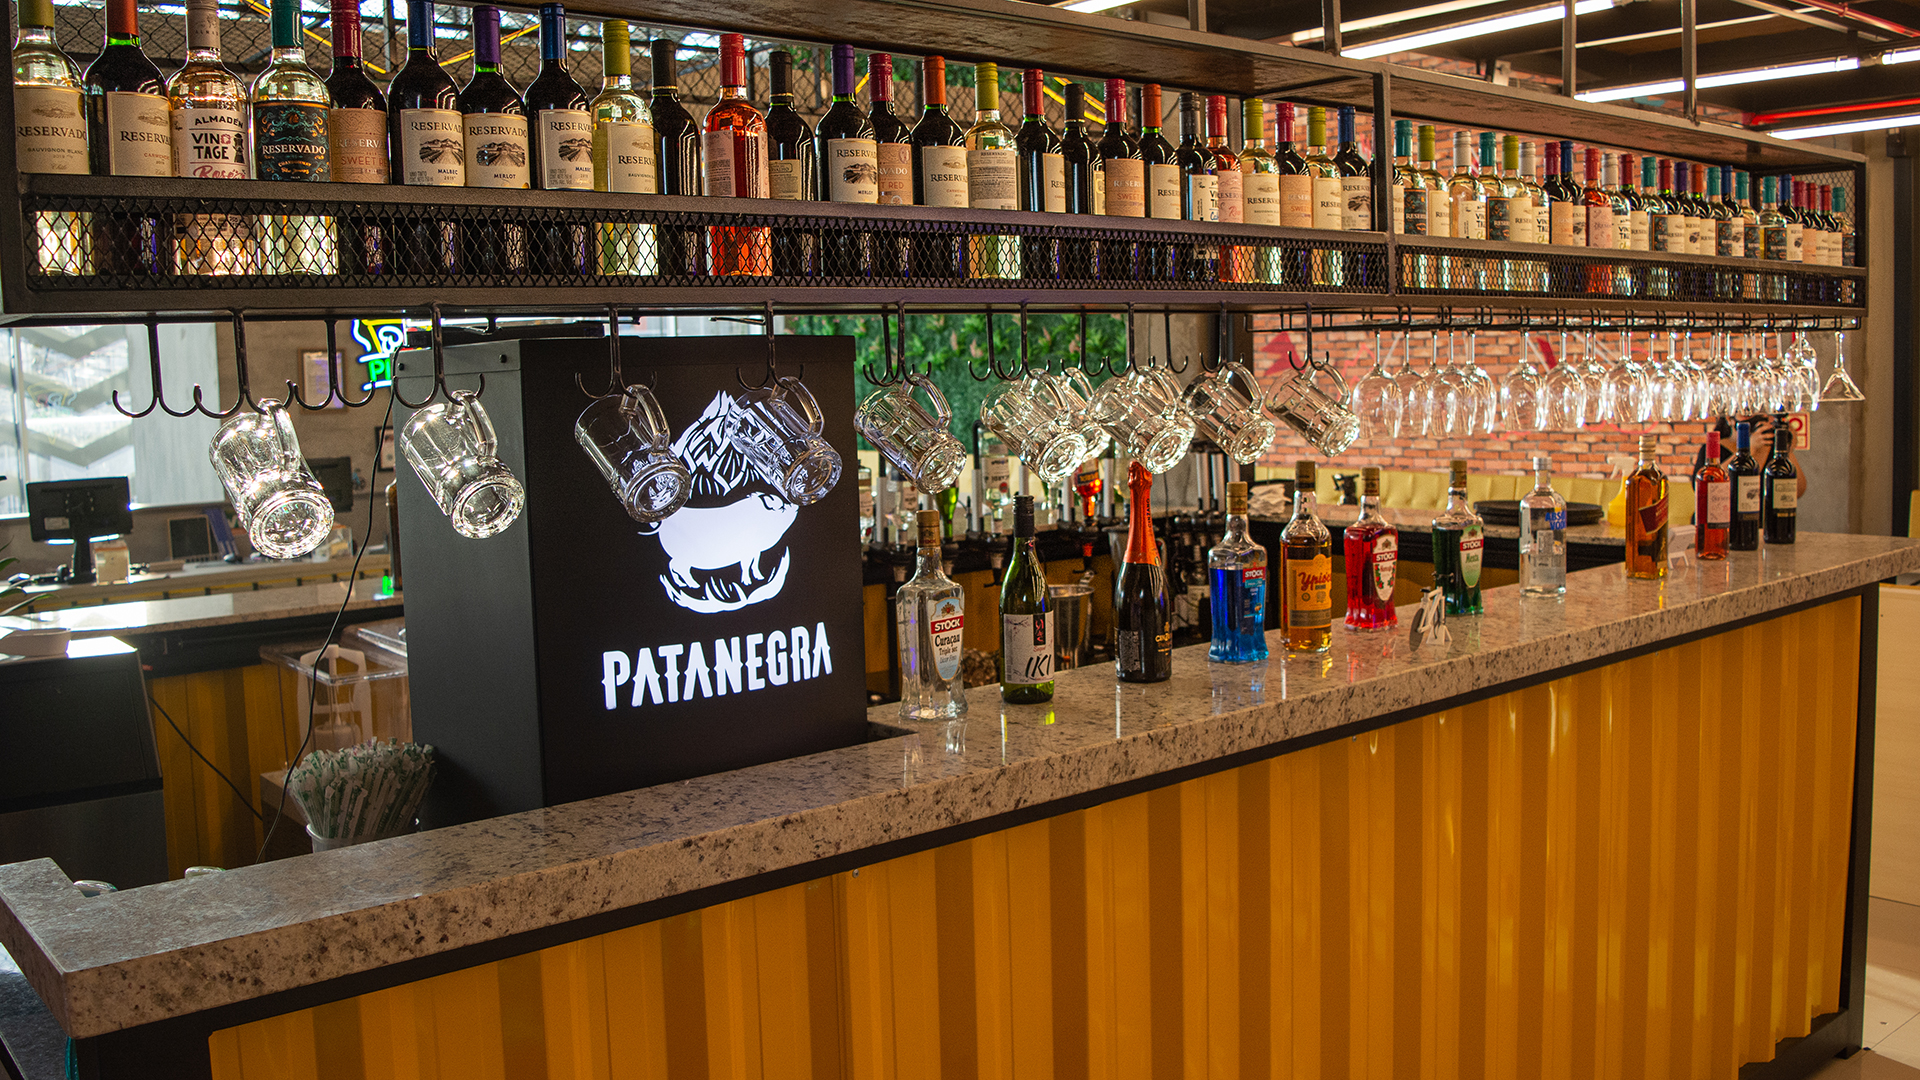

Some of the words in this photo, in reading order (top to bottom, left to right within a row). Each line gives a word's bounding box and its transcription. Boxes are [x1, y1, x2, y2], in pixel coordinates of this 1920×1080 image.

[193, 145, 230, 160] TAGE
[262, 144, 326, 155] RESERVADO
[340, 156, 376, 166] SWEET
[888, 181, 905, 190] RED
[1462, 540, 1482, 550] STOCK
[1375, 552, 1396, 562] STOCK
[1244, 568, 1264, 579] STOCK
[934, 618, 961, 632] STOCK
[601, 621, 833, 710] PATANEGRA
[1025, 654, 1052, 678] IKI
